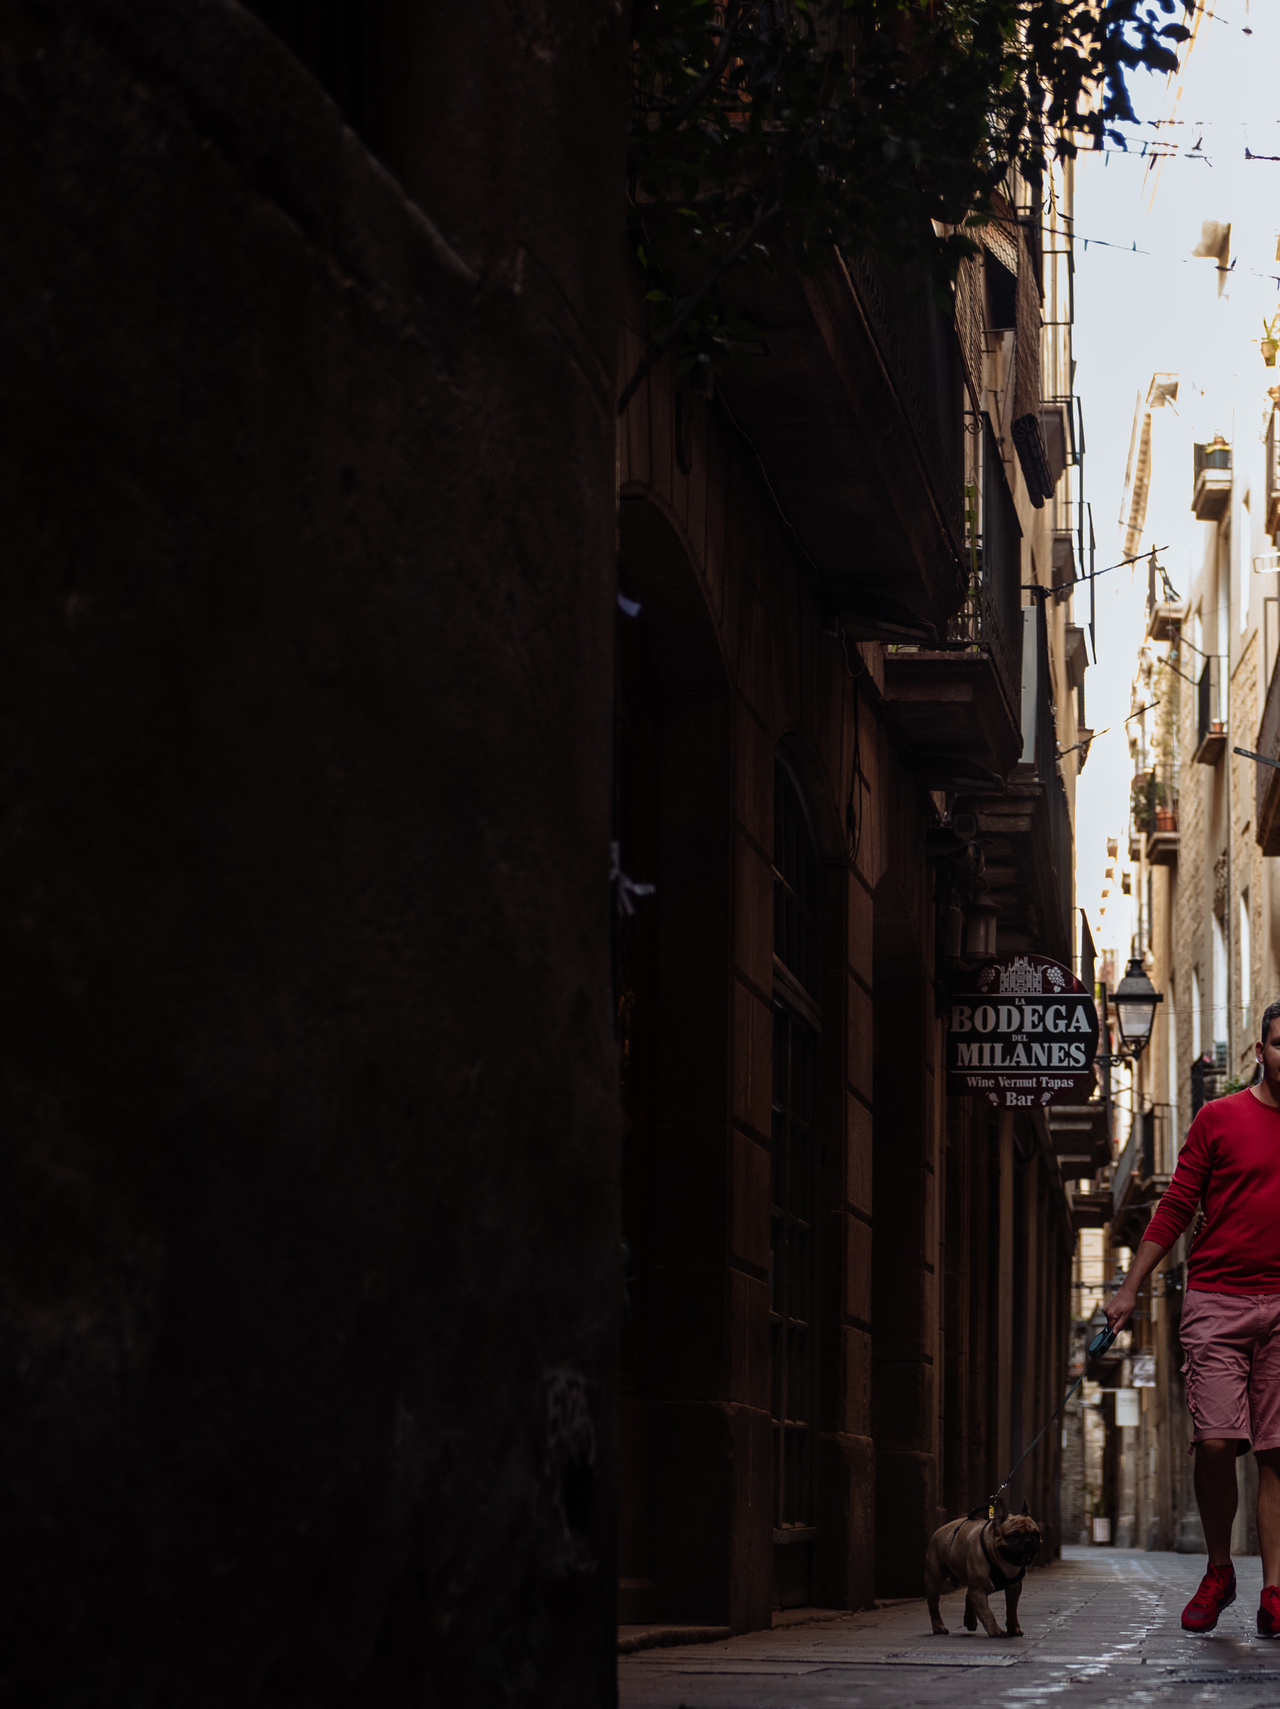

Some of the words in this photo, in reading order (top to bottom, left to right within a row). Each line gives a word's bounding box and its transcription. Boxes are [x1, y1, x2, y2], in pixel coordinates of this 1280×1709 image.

[951, 1005, 1092, 1033] BODEGA
[956, 1043, 1086, 1067] MILANES
[967, 1077, 995, 1088] Wine
[998, 1077, 1037, 1088] Vermut
[1040, 1077, 1074, 1090] Tapas
[1006, 1092, 1034, 1106] Bar
